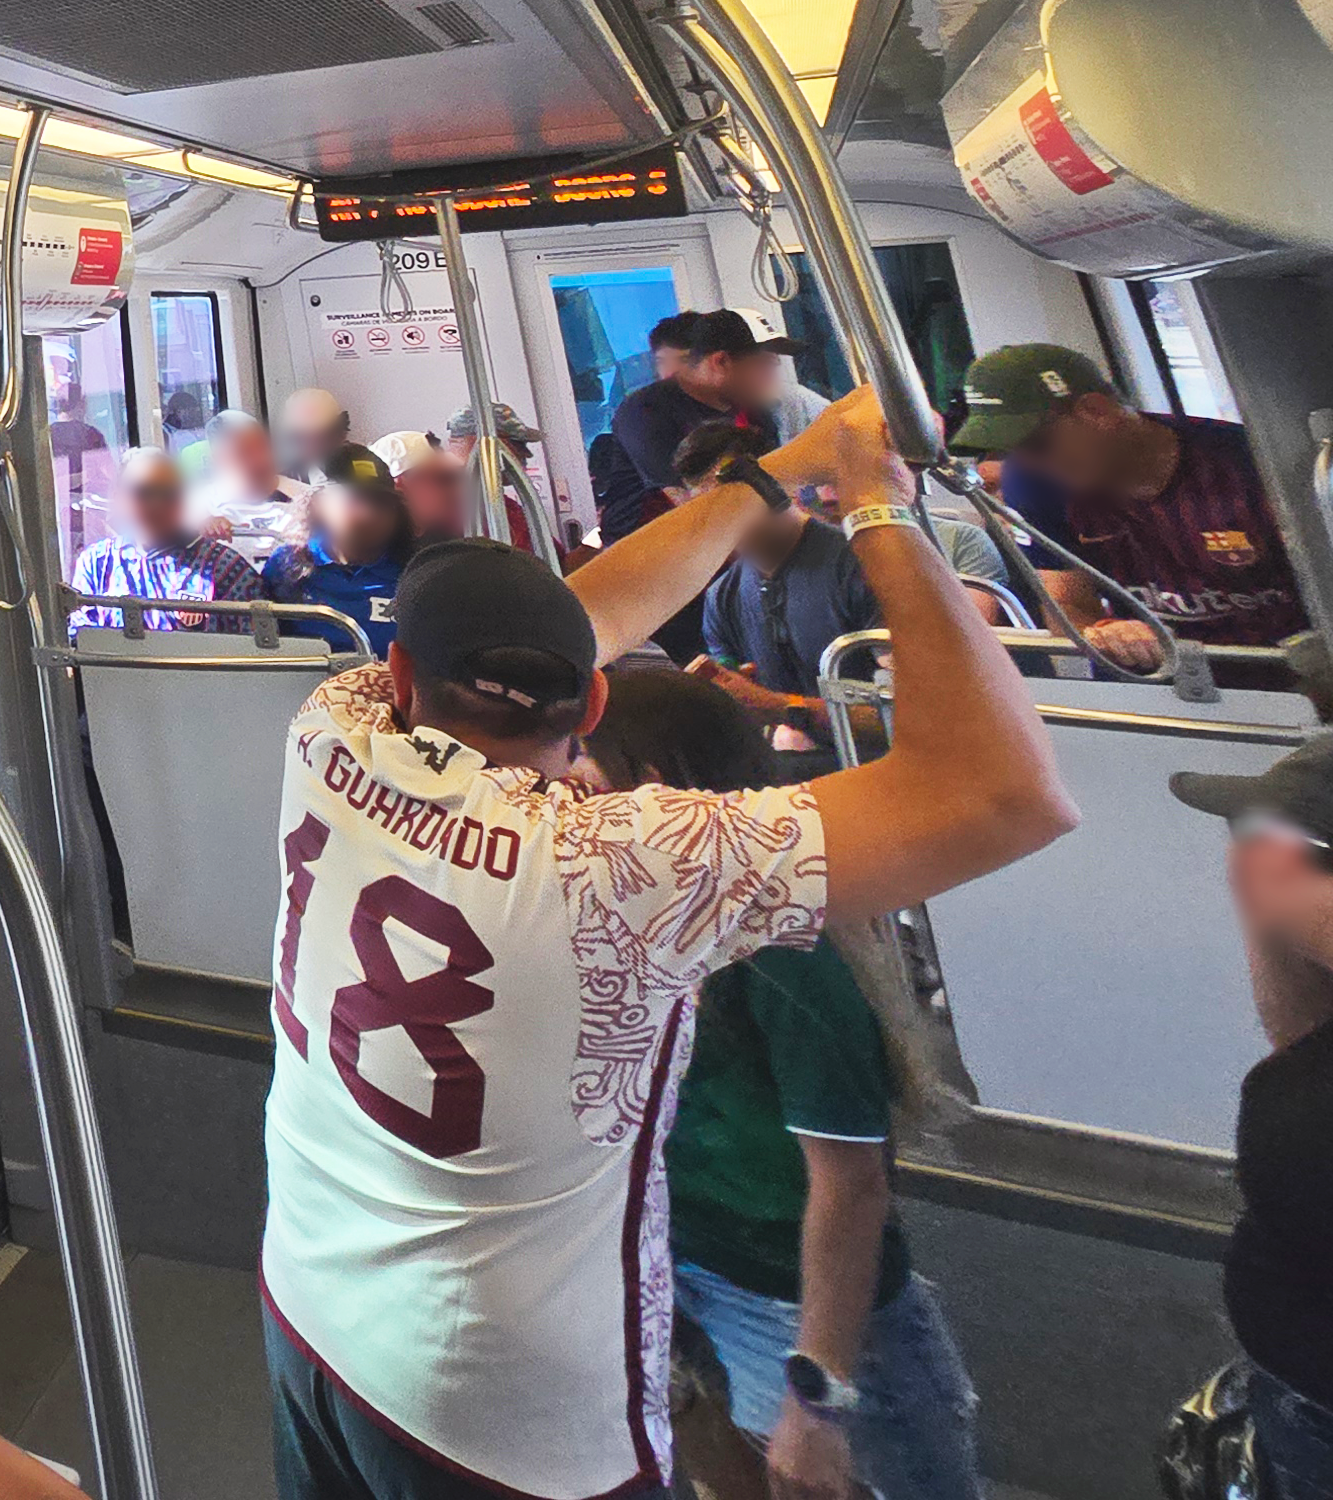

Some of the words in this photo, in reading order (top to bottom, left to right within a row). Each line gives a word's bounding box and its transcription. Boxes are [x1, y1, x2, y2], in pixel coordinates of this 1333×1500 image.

[326, 312, 380, 321] SURVEILLANCE
[432, 308, 456, 316] BOAR
[271, 810, 496, 1161] 18
